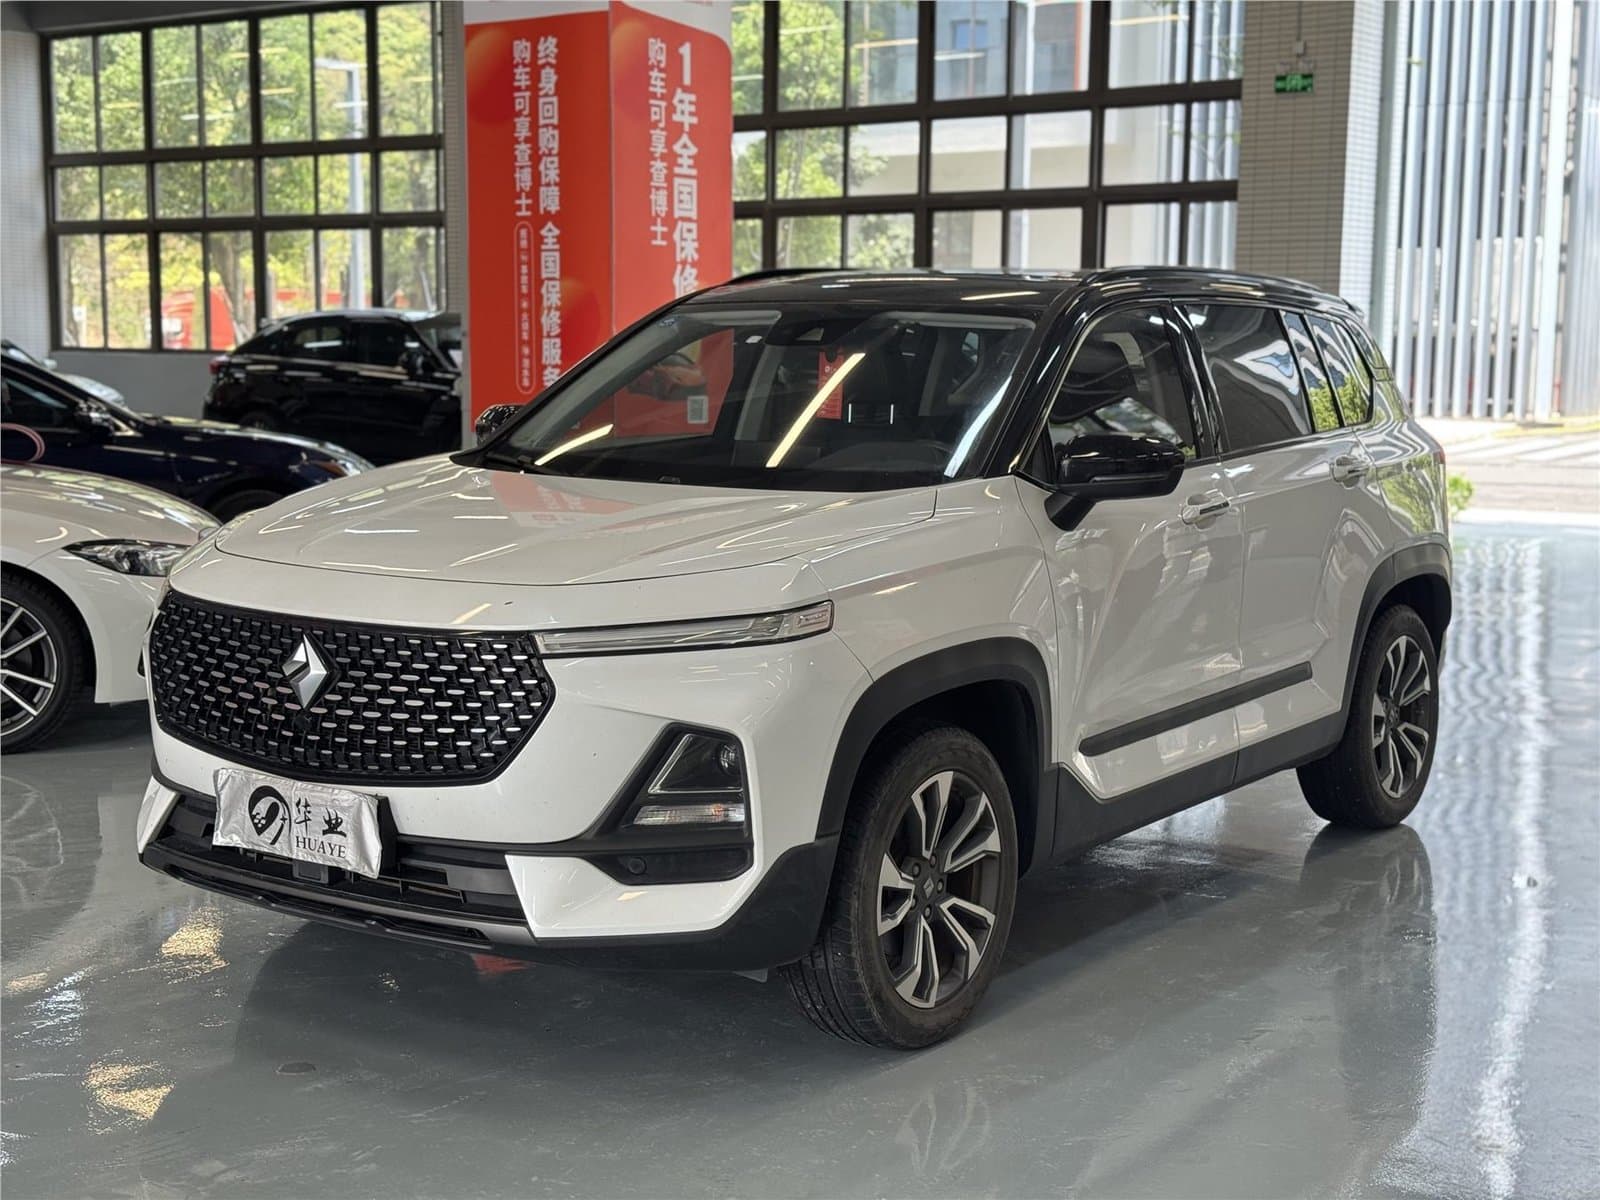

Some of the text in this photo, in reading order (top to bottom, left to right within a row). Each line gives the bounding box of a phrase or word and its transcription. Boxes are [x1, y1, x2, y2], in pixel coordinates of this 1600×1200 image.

[512, 39, 532, 217] 购车可享查博士
[537, 36, 560, 215] 终身回购保障
[648, 38, 668, 246] 购车可享查博士
[672, 42, 698, 299] 1年全国保修
[295, 797, 347, 837] 华业
[296, 836, 346, 859] HUAYE
